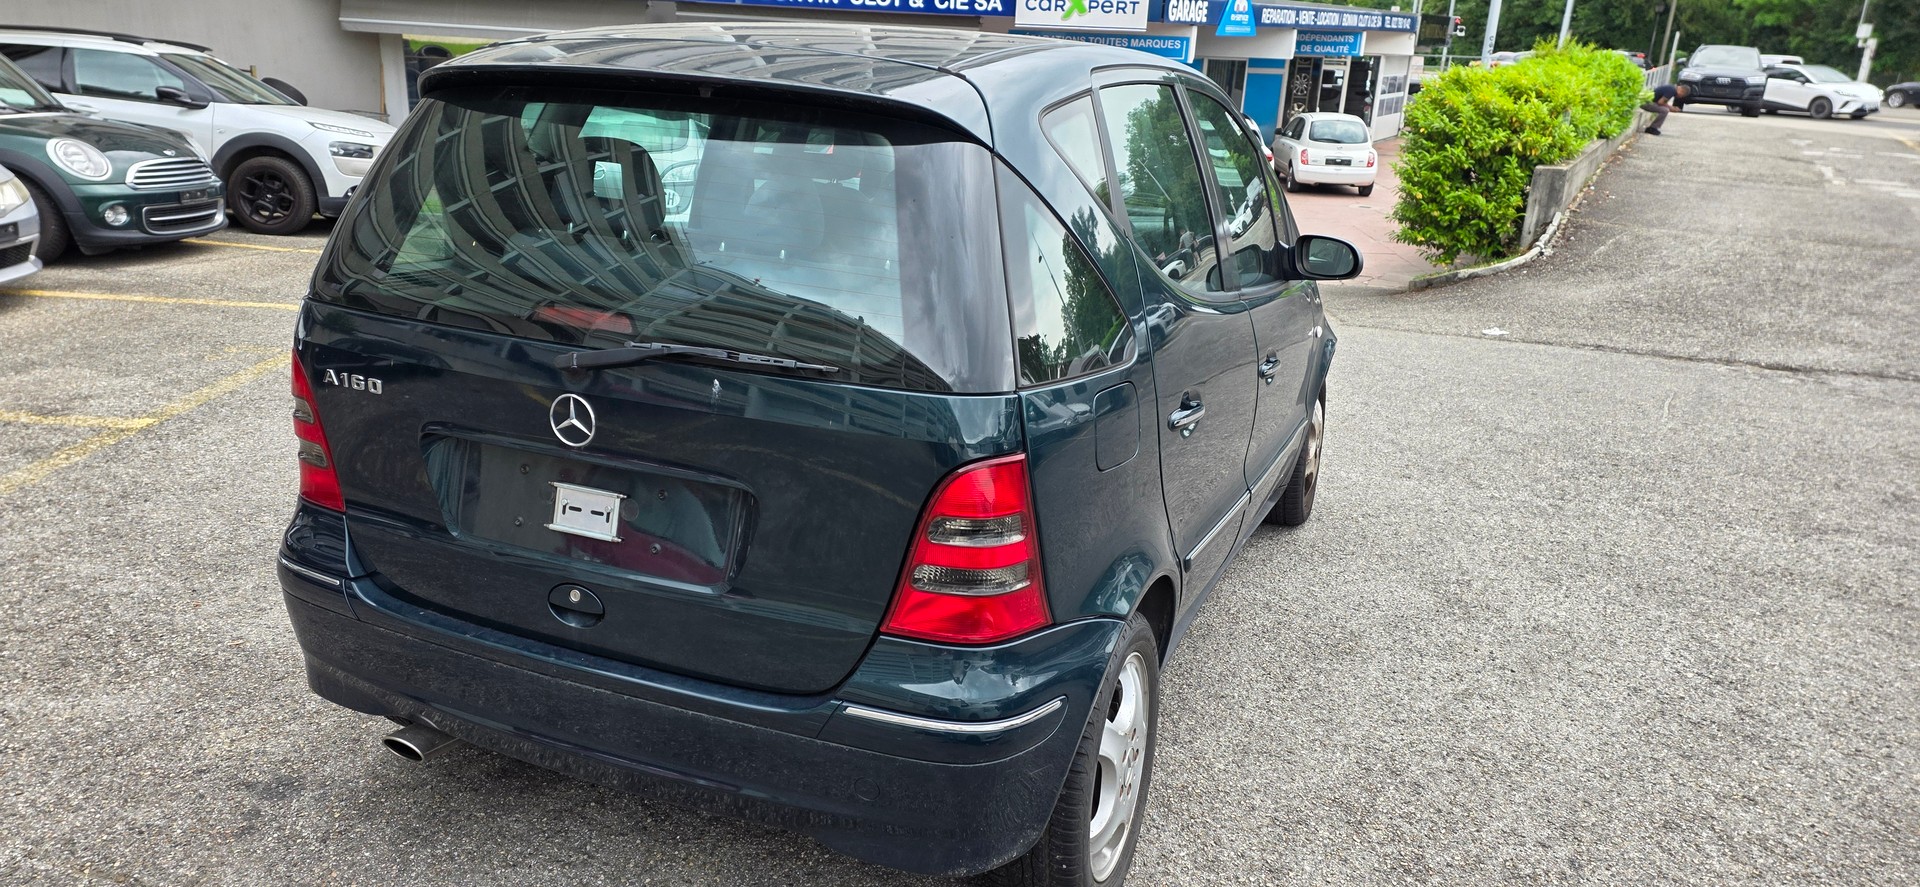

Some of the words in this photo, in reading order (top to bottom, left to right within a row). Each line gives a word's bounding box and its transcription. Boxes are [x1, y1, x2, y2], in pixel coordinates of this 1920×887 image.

[974, 0, 1003, 12] SA
[1168, 0, 1208, 22] GARAGE
[1088, 36, 1129, 47] TOUTES
[1130, 38, 1181, 49] MARQUES
[1296, 33, 1354, 43] NDÉPENDANTS
[1300, 44, 1312, 52] DE
[1313, 44, 1350, 54] QUALITÉ
[323, 368, 383, 395] A160
